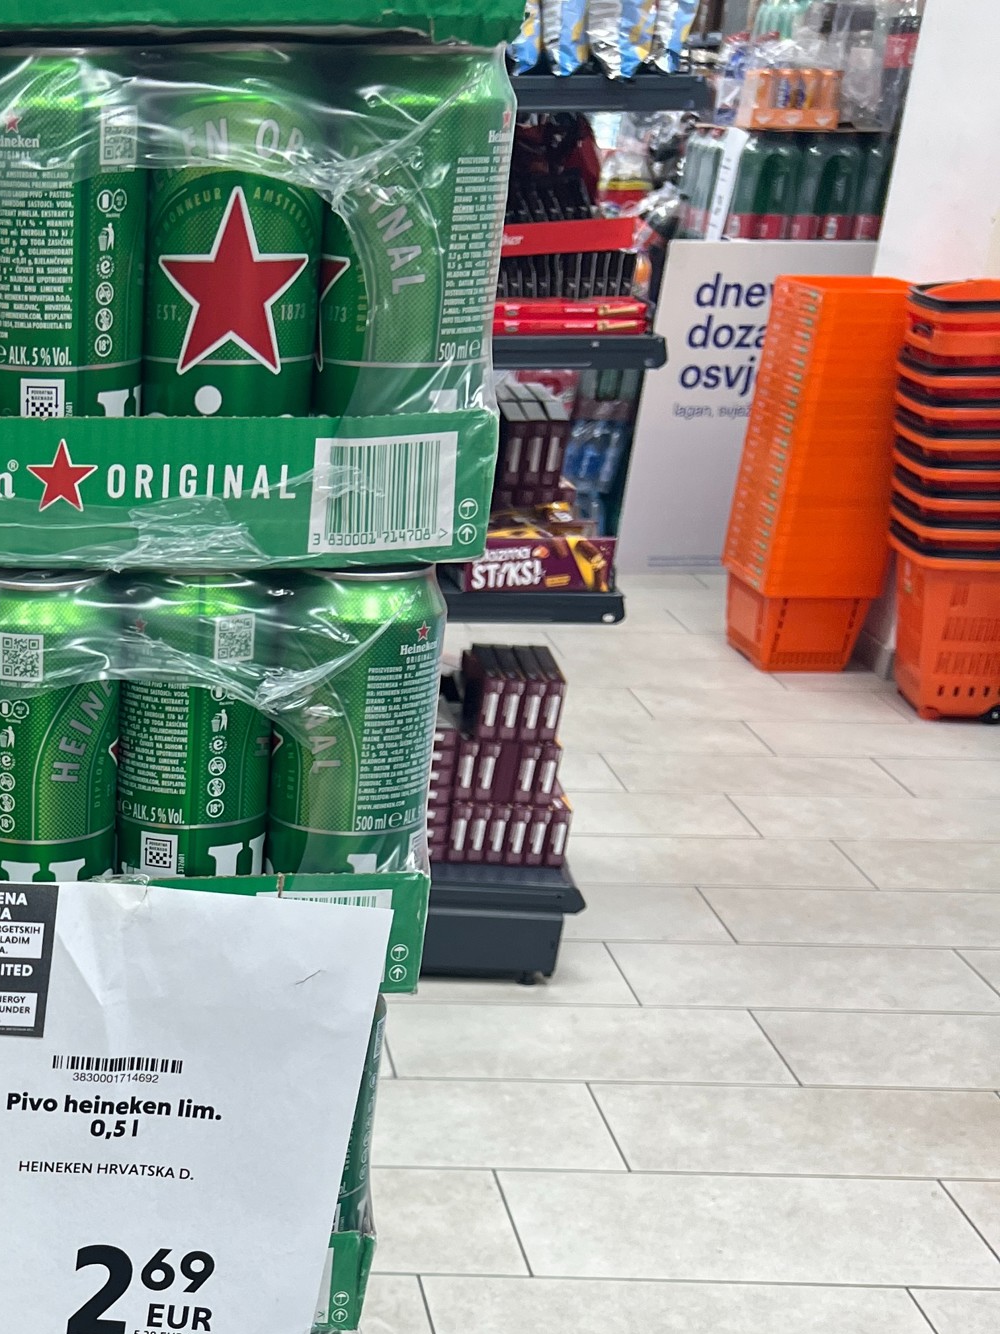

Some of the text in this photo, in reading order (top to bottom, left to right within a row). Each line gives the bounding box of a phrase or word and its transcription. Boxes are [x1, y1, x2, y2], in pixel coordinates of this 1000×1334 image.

[695, 272, 775, 308] dne
[8, 345, 30, 365] ALK.
[31, 346, 39, 365] 5
[52, 346, 72, 365] Vol.
[106, 464, 297, 500] ORIGINAL
[312, 528, 431, 546] 3 830001 714708
[72, 1072, 160, 1084] 3830001714692
[6, 1091, 222, 1121] Pivo heineken lim.
[90, 1118, 127, 1140] 0,5
[18, 1160, 195, 1181] HEINEKEN HRVATSKA D.
[140, 1247, 216, 1294] 69
[146, 1302, 213, 1332] EUR
